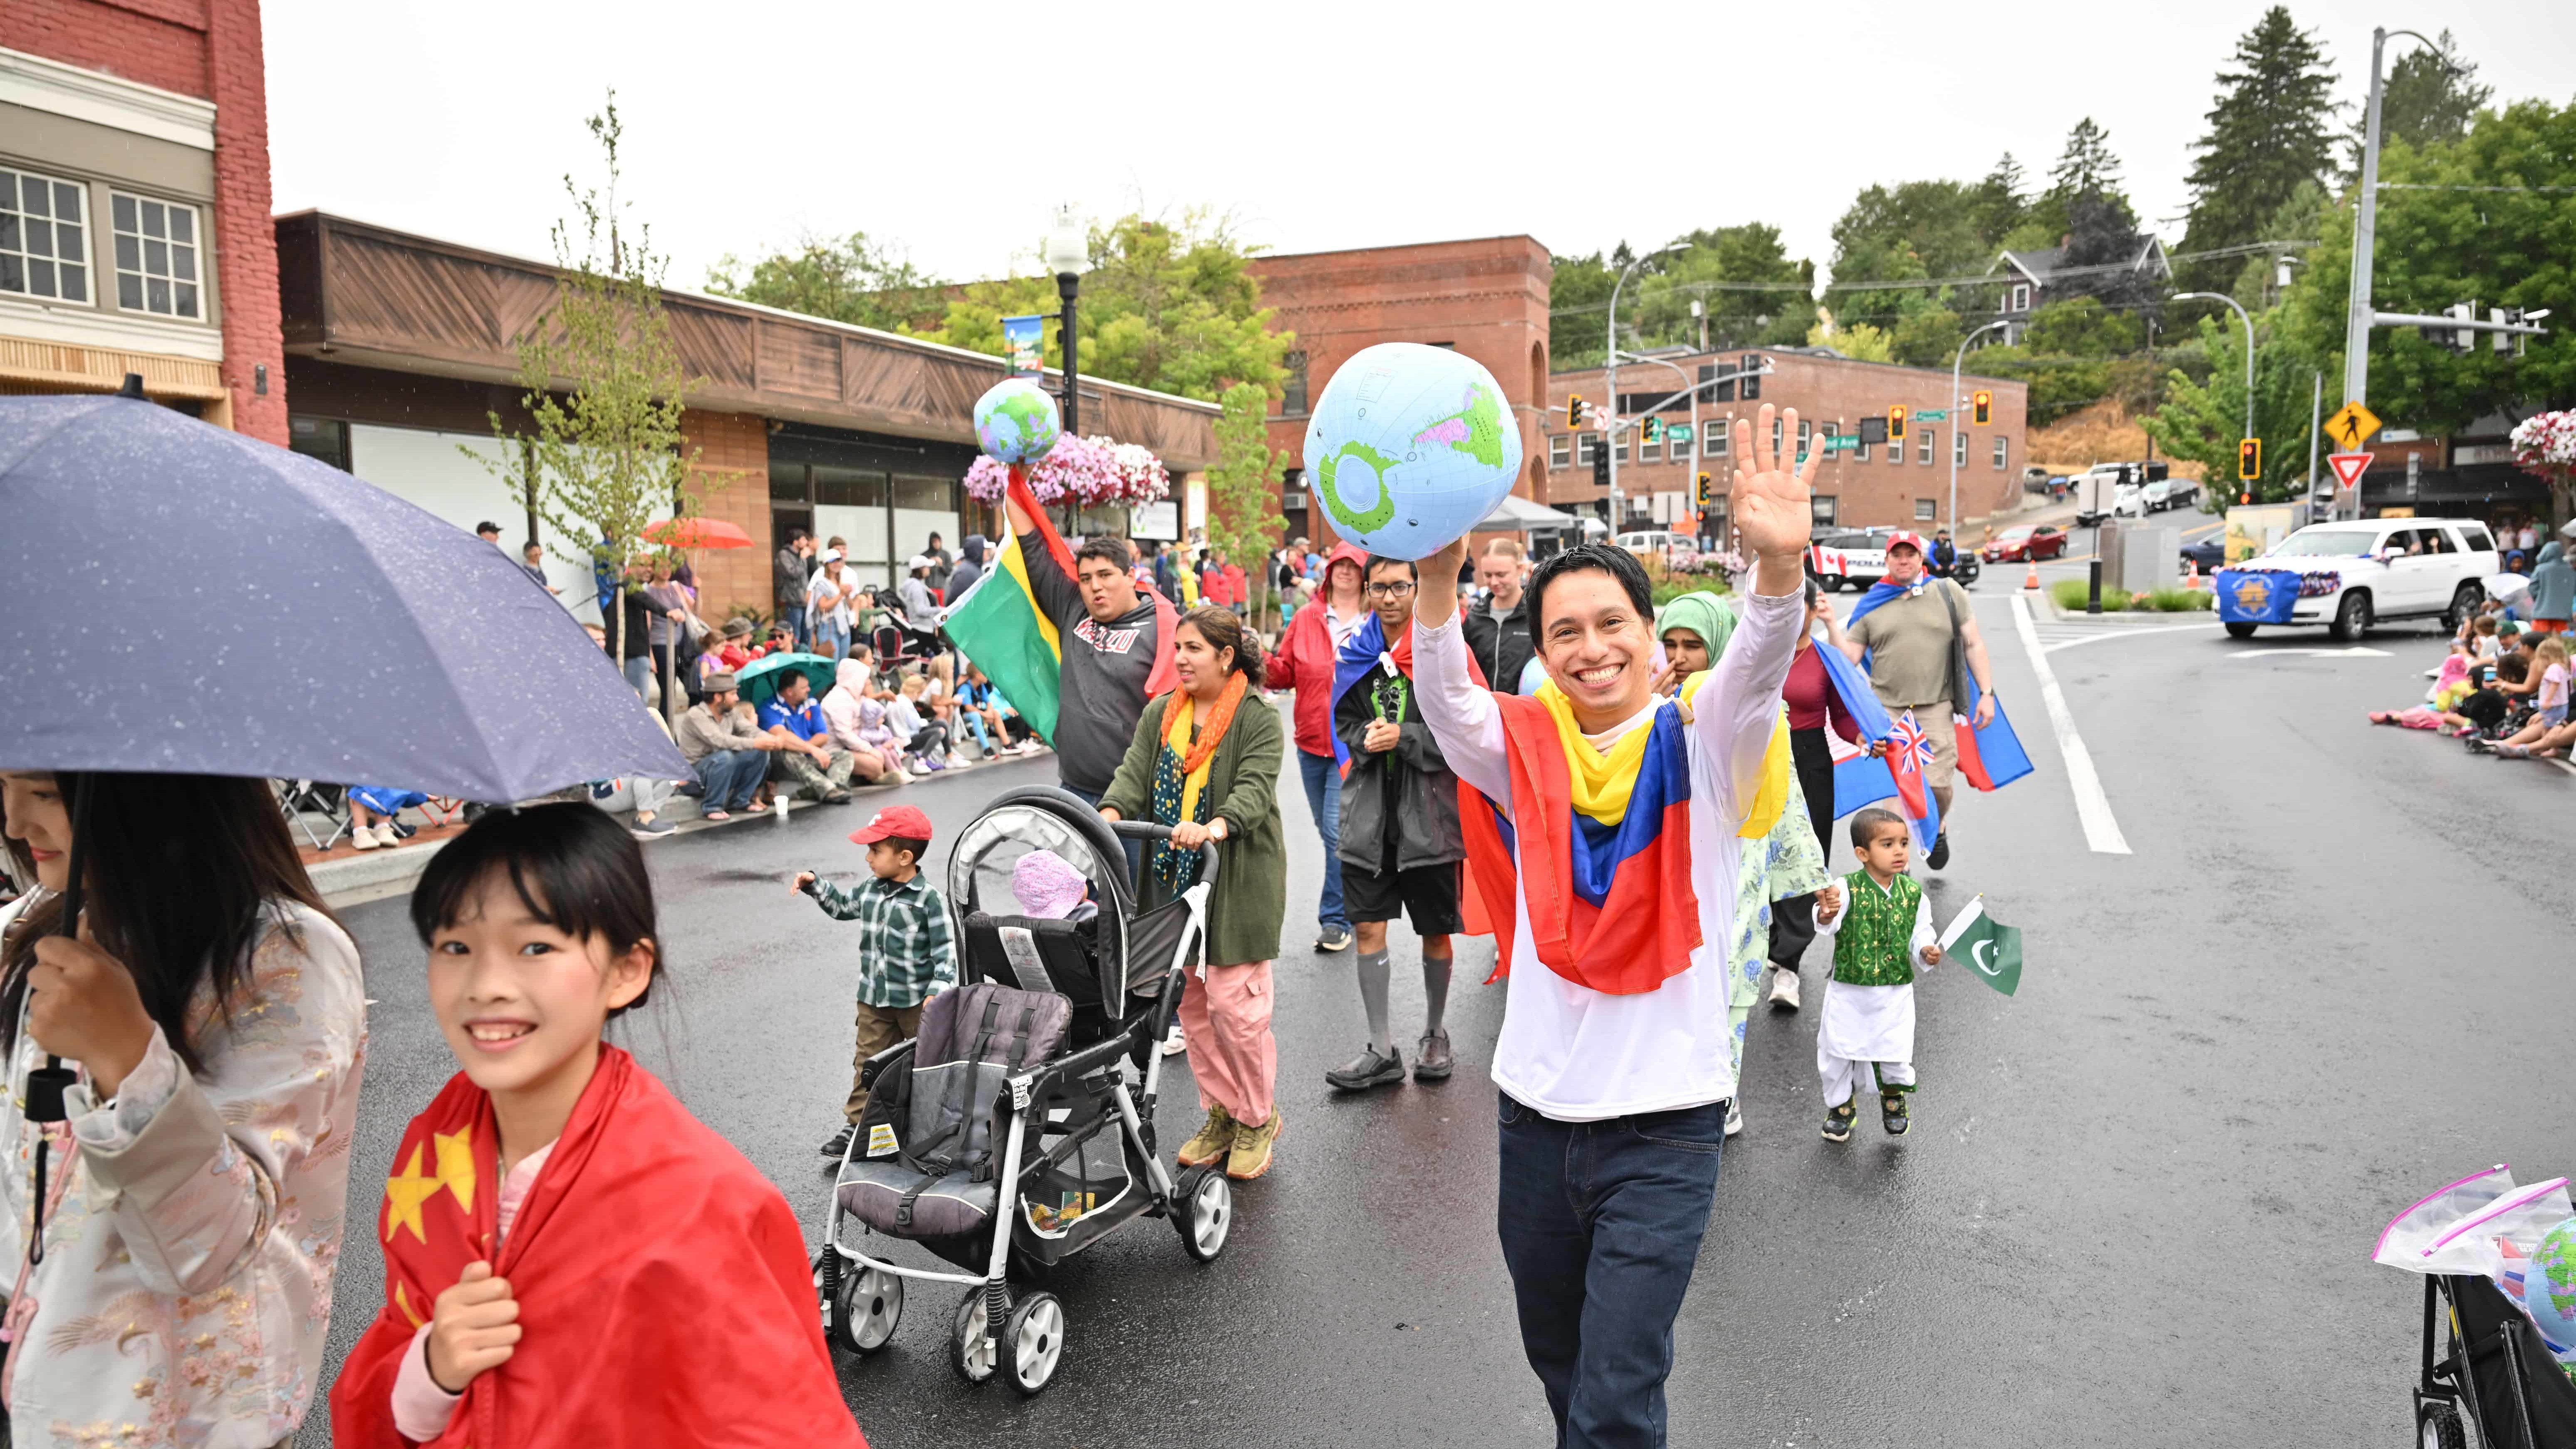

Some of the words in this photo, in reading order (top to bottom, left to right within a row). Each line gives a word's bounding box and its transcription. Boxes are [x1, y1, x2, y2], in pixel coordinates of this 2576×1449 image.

[1475, 418, 1486, 442] AMERICA
[1481, 417, 1490, 435] SOUTH
[1840, 438, 1858, 447] Ave
[1898, 530, 1910, 540] W
